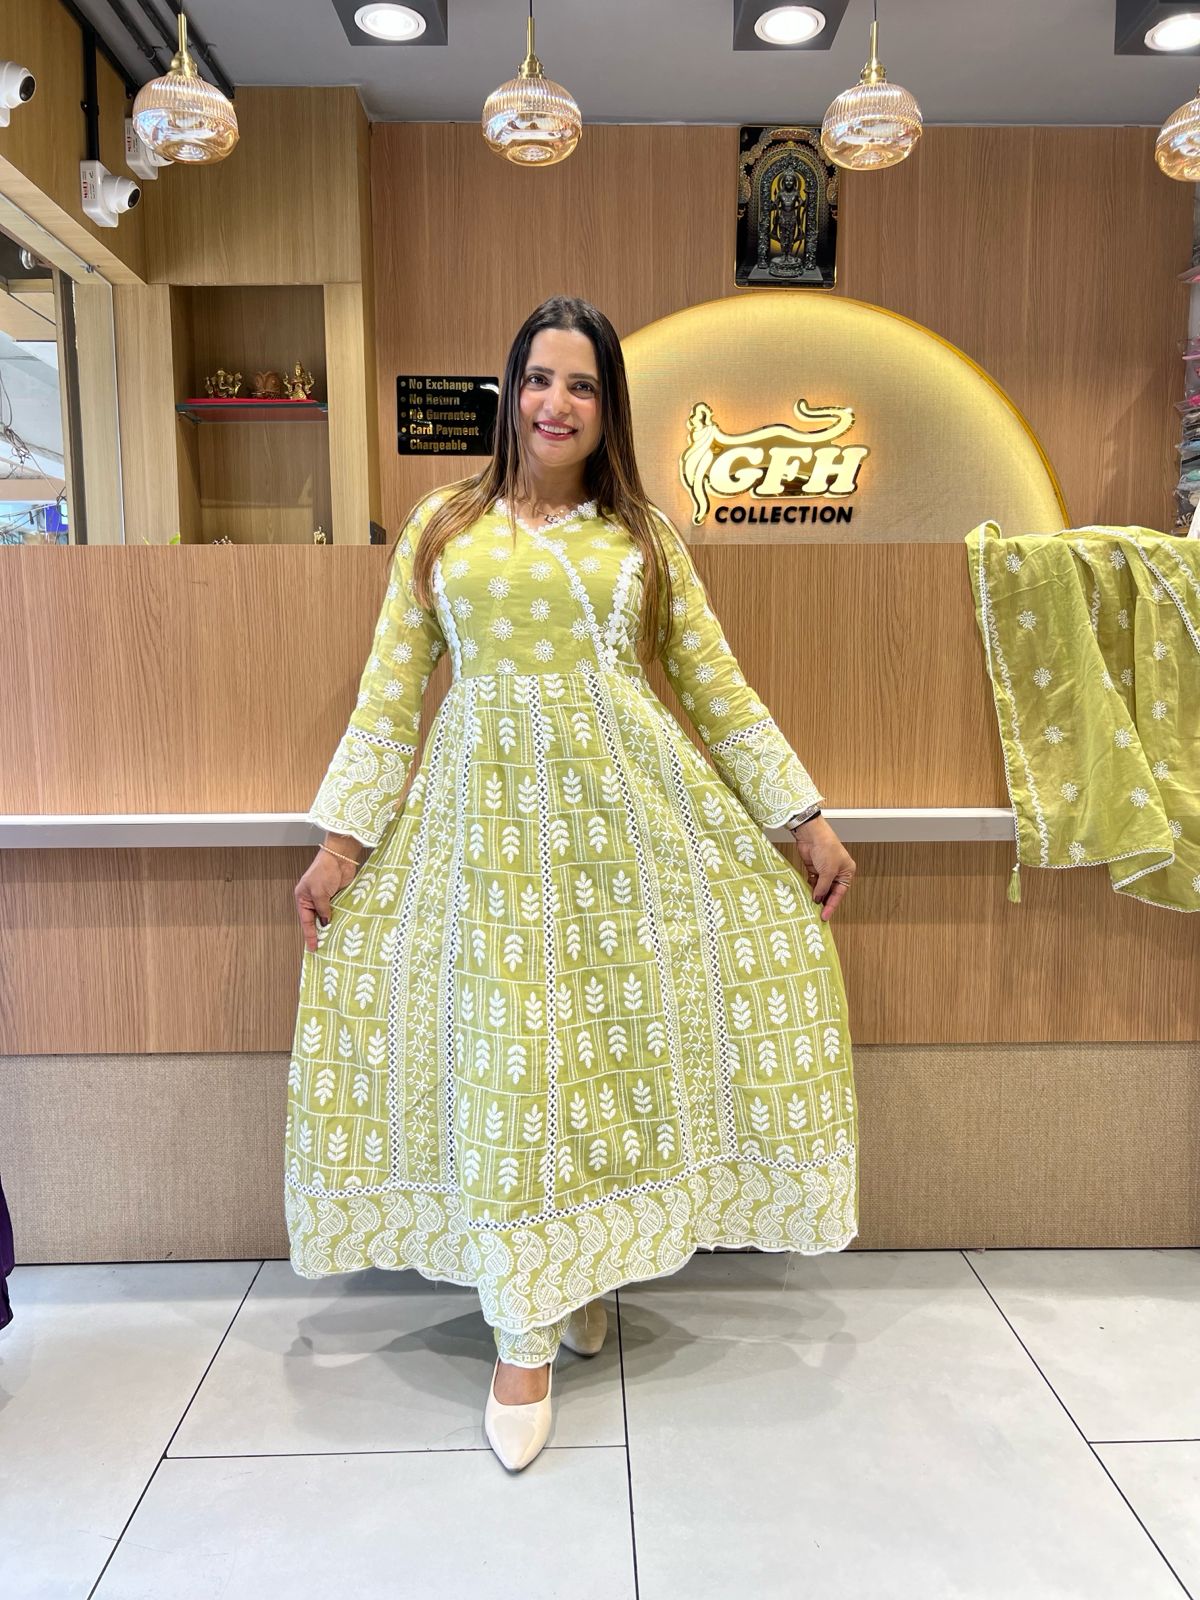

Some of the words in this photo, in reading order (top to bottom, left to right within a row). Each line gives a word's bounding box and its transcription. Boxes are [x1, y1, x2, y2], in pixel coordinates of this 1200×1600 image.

[409, 379, 422, 390] No
[426, 379, 473, 392] Exchange
[409, 394, 423, 405] No
[426, 394, 460, 405] Return
[409, 409, 423, 420] No
[409, 424, 433, 435] Card
[436, 425, 479, 437] Payment
[410, 440, 467, 452] Chargeable
[708, 447, 869, 495] GFH
[715, 506, 853, 524] COLLECTION
